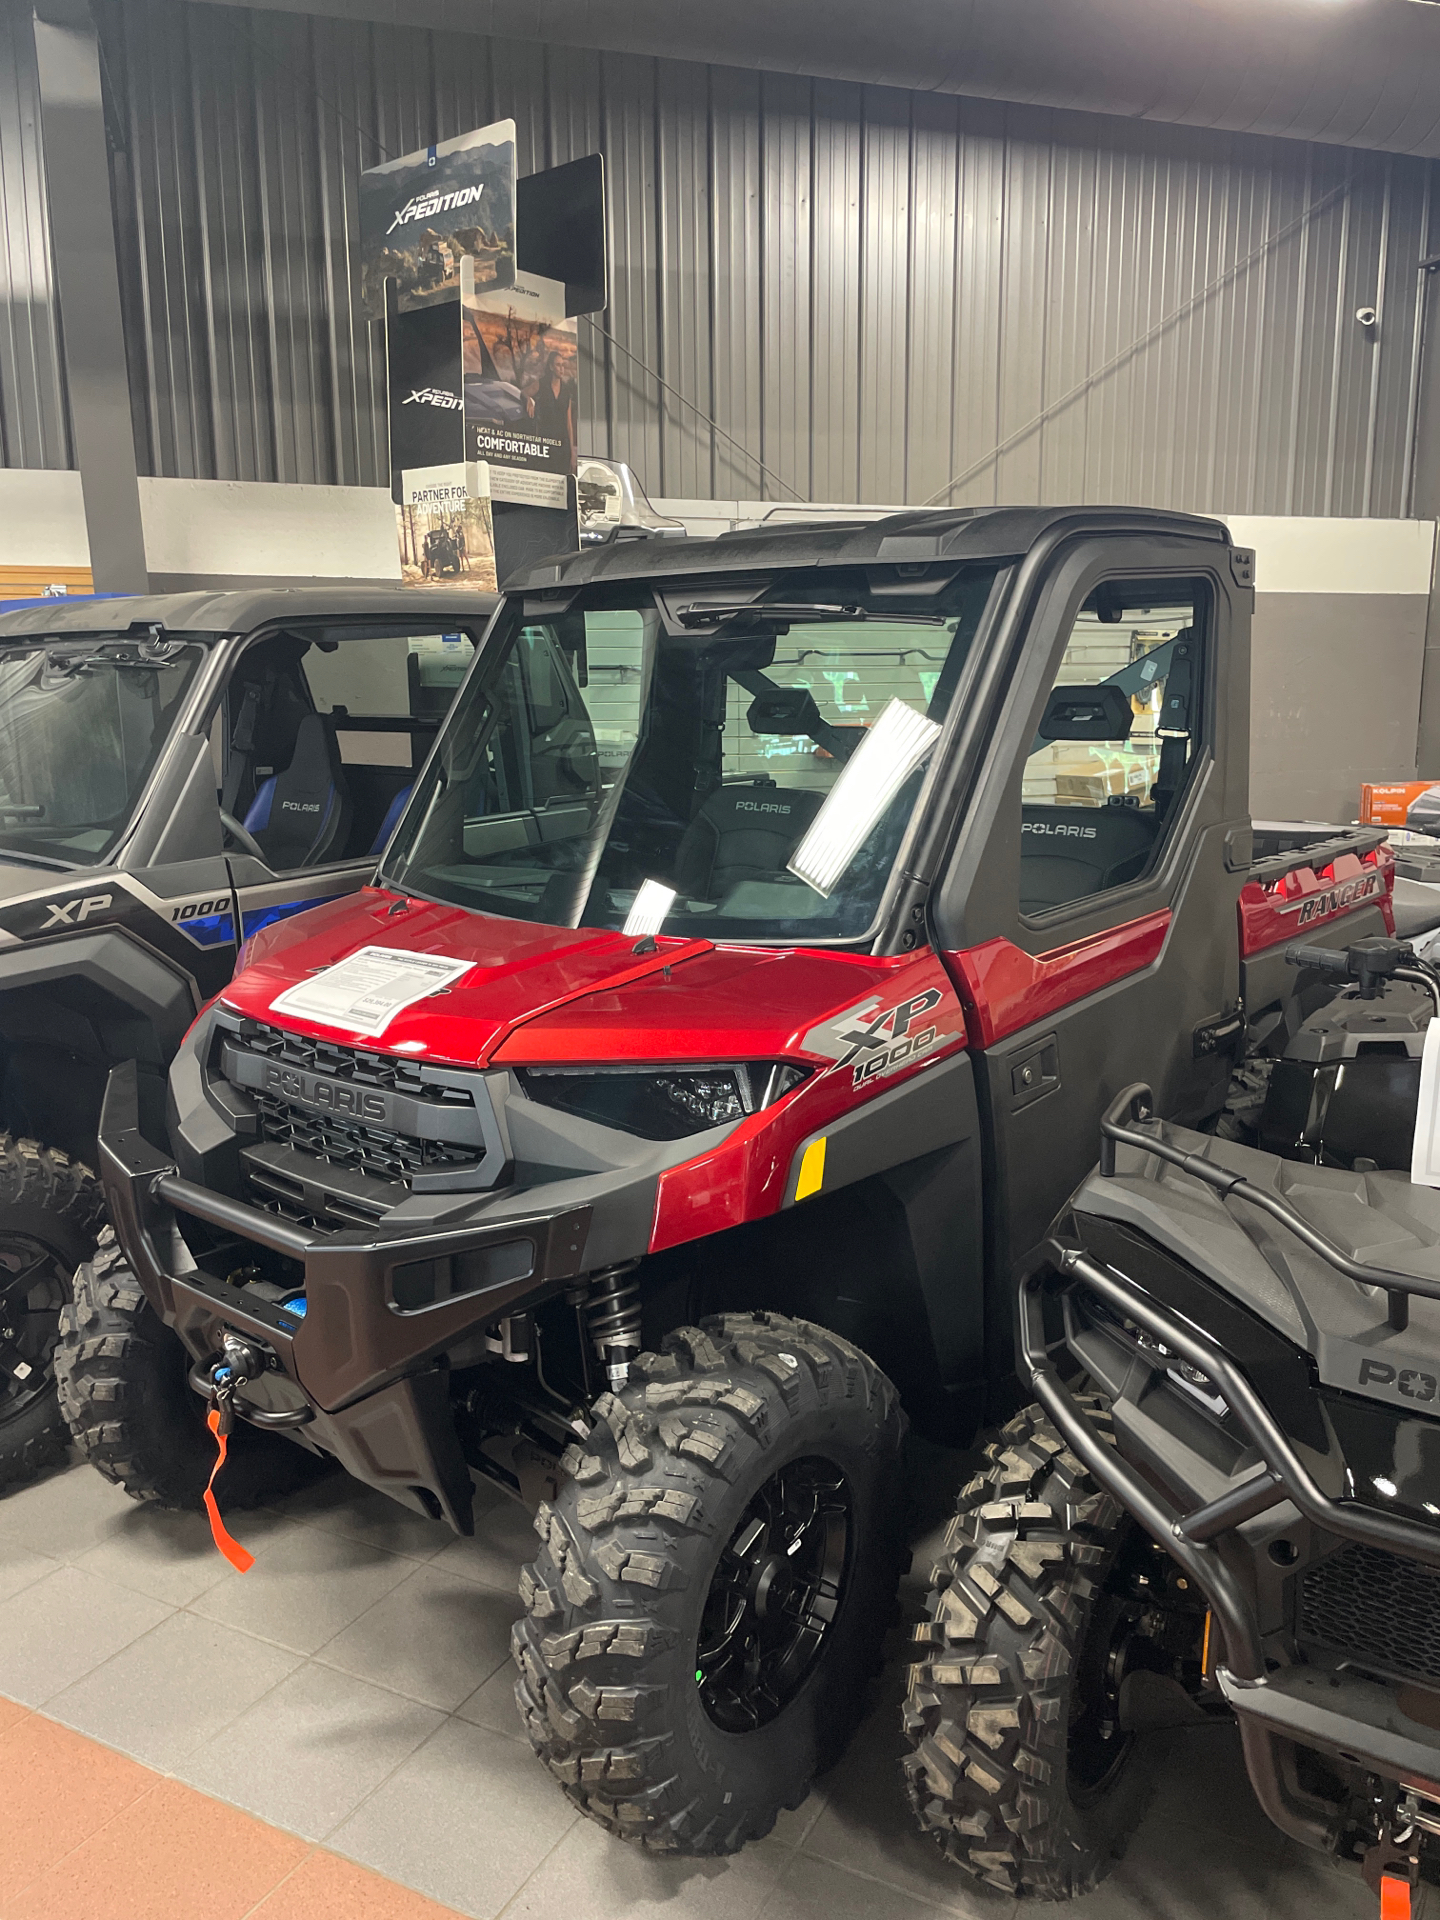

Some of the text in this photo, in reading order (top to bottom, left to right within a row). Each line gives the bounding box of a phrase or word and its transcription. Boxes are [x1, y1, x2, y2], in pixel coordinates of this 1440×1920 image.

[386, 183, 484, 235] XPEDITION
[477, 435, 549, 458] COMFORTABLE
[496, 429, 504, 437] AC
[512, 432, 542, 443] NORTHSTAR
[542, 437, 562, 447] MODELS
[412, 486, 469, 503] PARTNER FOR
[416, 499, 467, 516] ADVENTURE
[282, 800, 321, 812] POLARIS
[735, 801, 792, 815] POLARIS
[1020, 823, 1097, 839] POLARIS
[171, 898, 231, 921] 1000
[1297, 873, 1378, 926] RANGER
[39, 894, 113, 930] XP
[822, 987, 943, 1079] XP
[851, 1025, 938, 1087] 1000
[852, 1045, 934, 1093] DUAL OVERHEAD CAM
[265, 1065, 387, 1122] POLARIS
